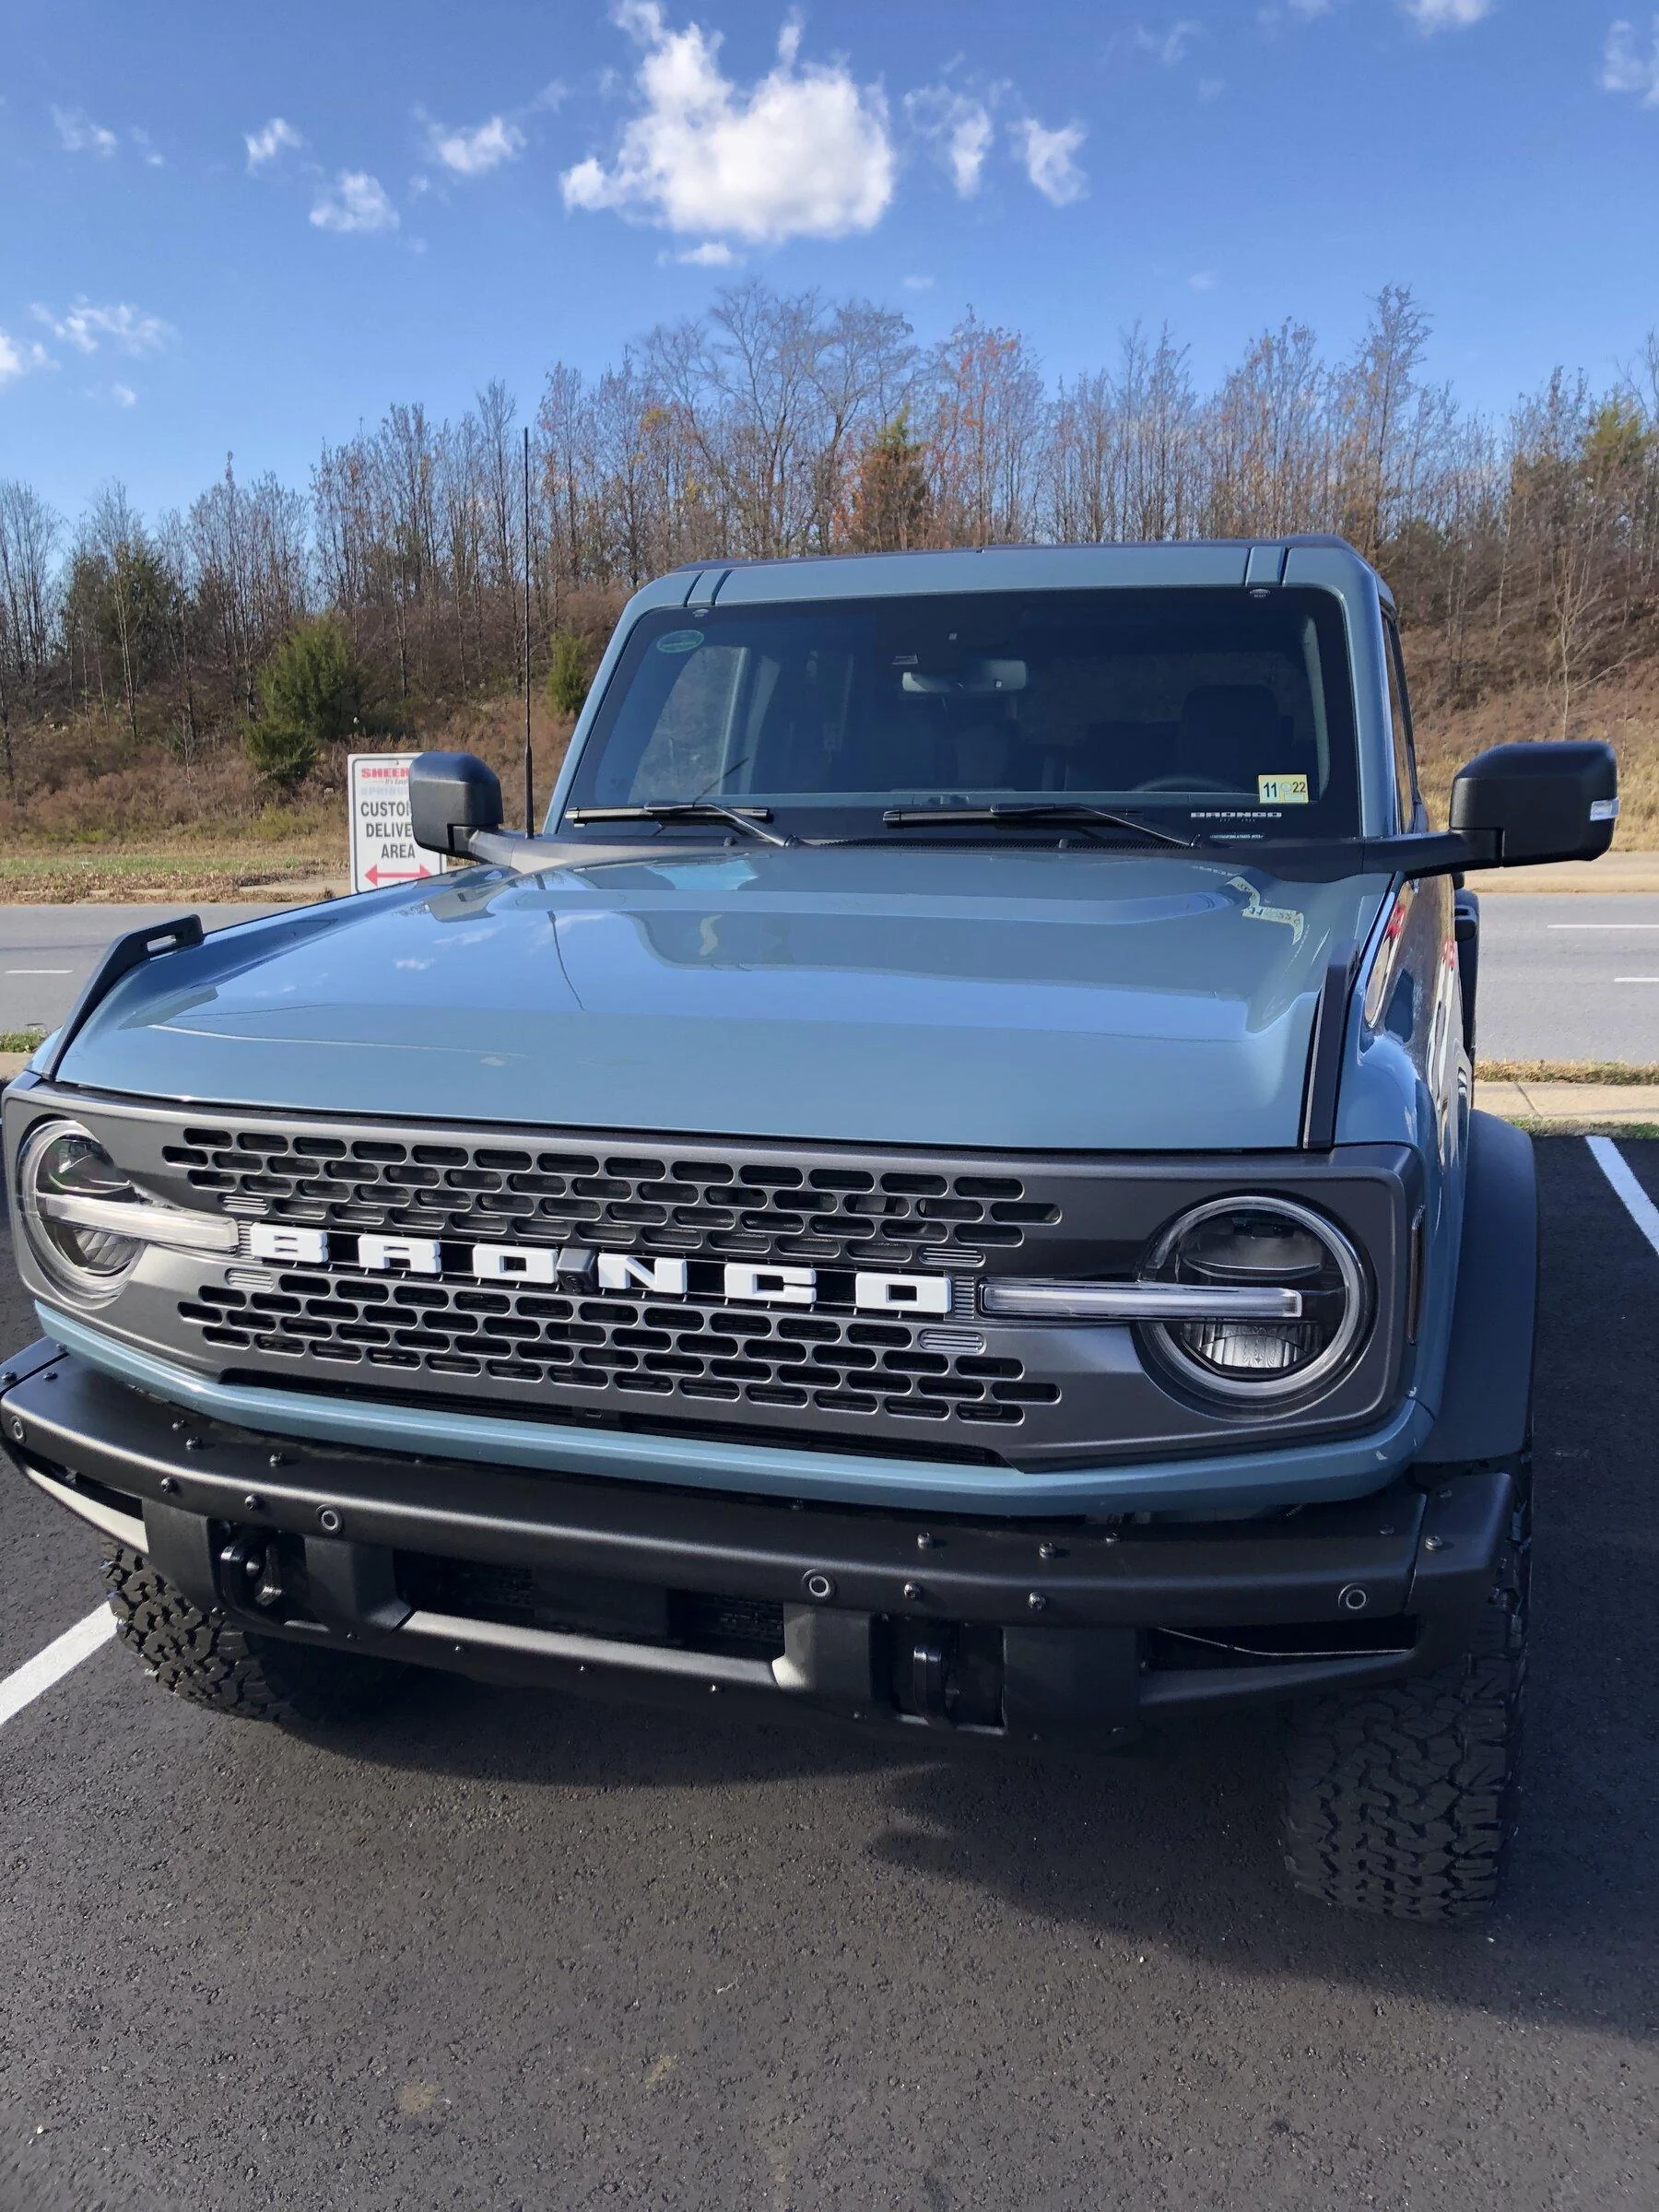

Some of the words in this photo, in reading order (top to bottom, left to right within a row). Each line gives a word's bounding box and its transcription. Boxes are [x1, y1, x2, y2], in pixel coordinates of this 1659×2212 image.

[1264, 782, 1277, 798] 11
[1292, 782, 1307, 794] 22
[360, 801, 409, 818] CUSTO
[381, 843, 416, 859] AREA
[251, 1222, 952, 1313] BRONCO
